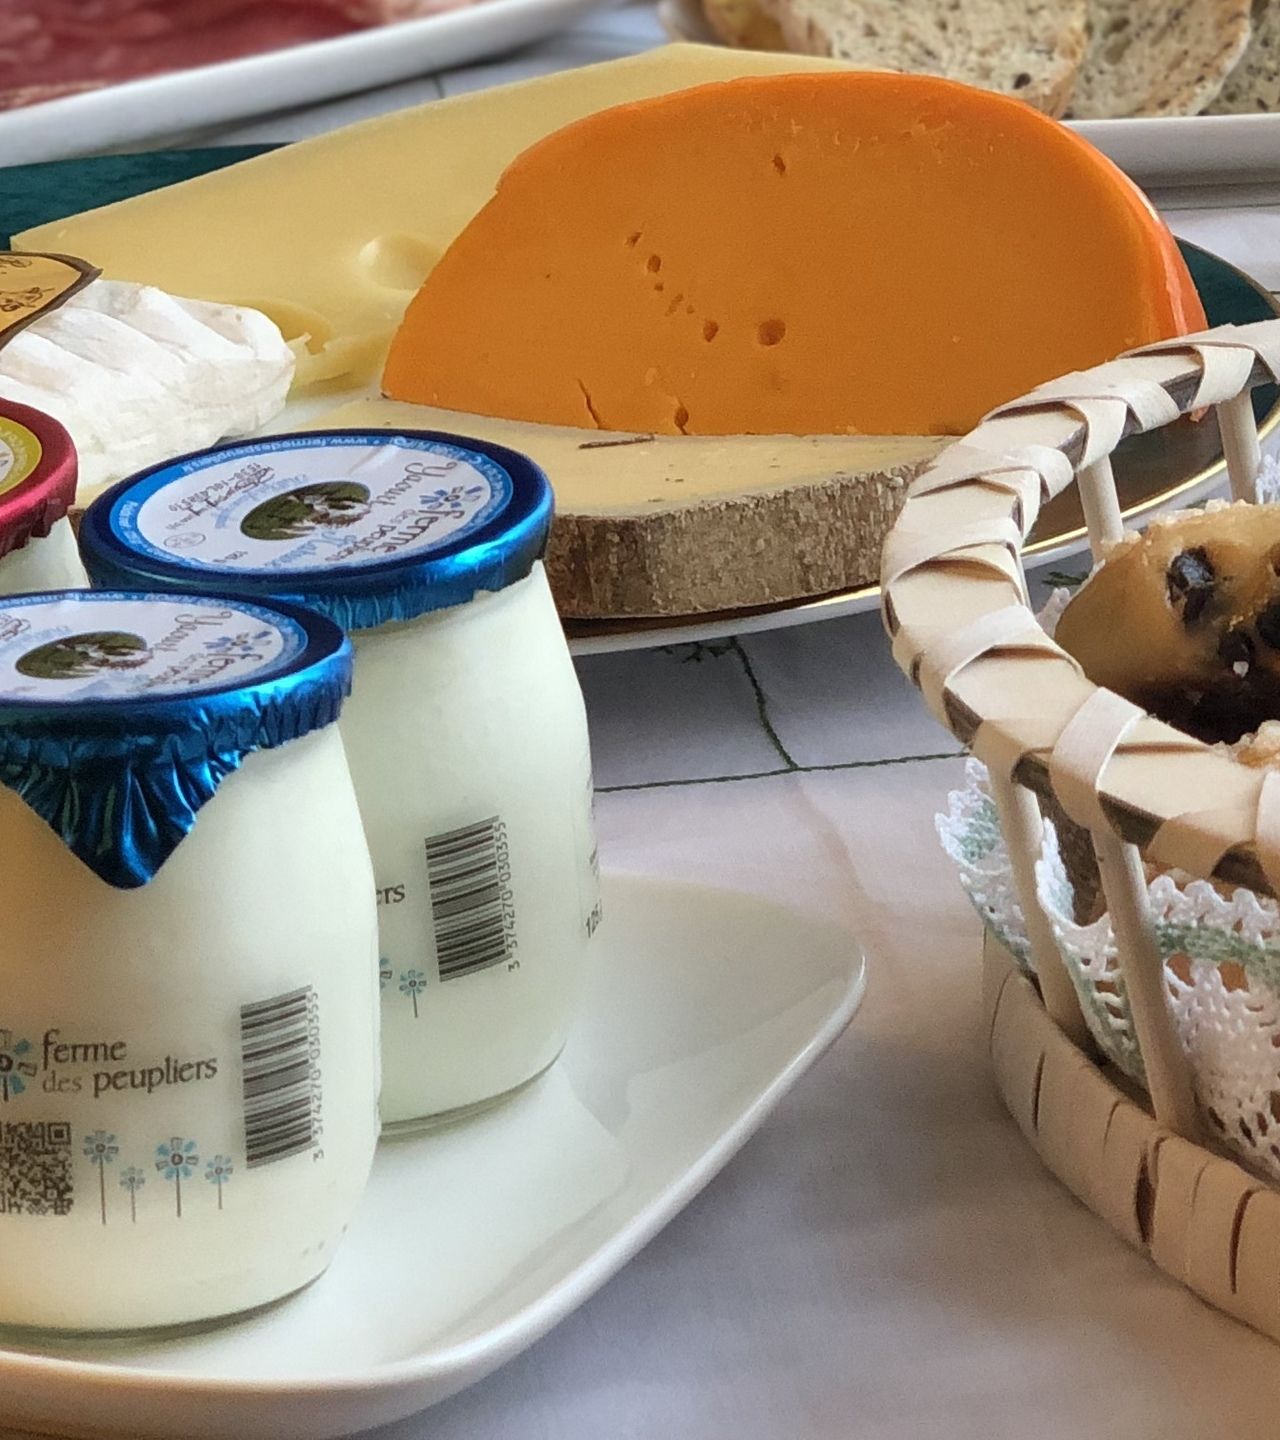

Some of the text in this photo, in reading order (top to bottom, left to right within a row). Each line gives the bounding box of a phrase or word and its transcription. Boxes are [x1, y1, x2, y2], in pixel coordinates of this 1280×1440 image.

[364, 462, 456, 515] Yaourt
[372, 511, 465, 554] ferme
[149, 612, 232, 652] Yaourt
[495, 822, 511, 883] 030355
[502, 891, 518, 951] 374270
[42, 1028, 126, 1070] ferme
[308, 992, 321, 1061] 030355
[42, 1056, 217, 1098] des peupliers
[311, 1069, 323, 1136] 374270
